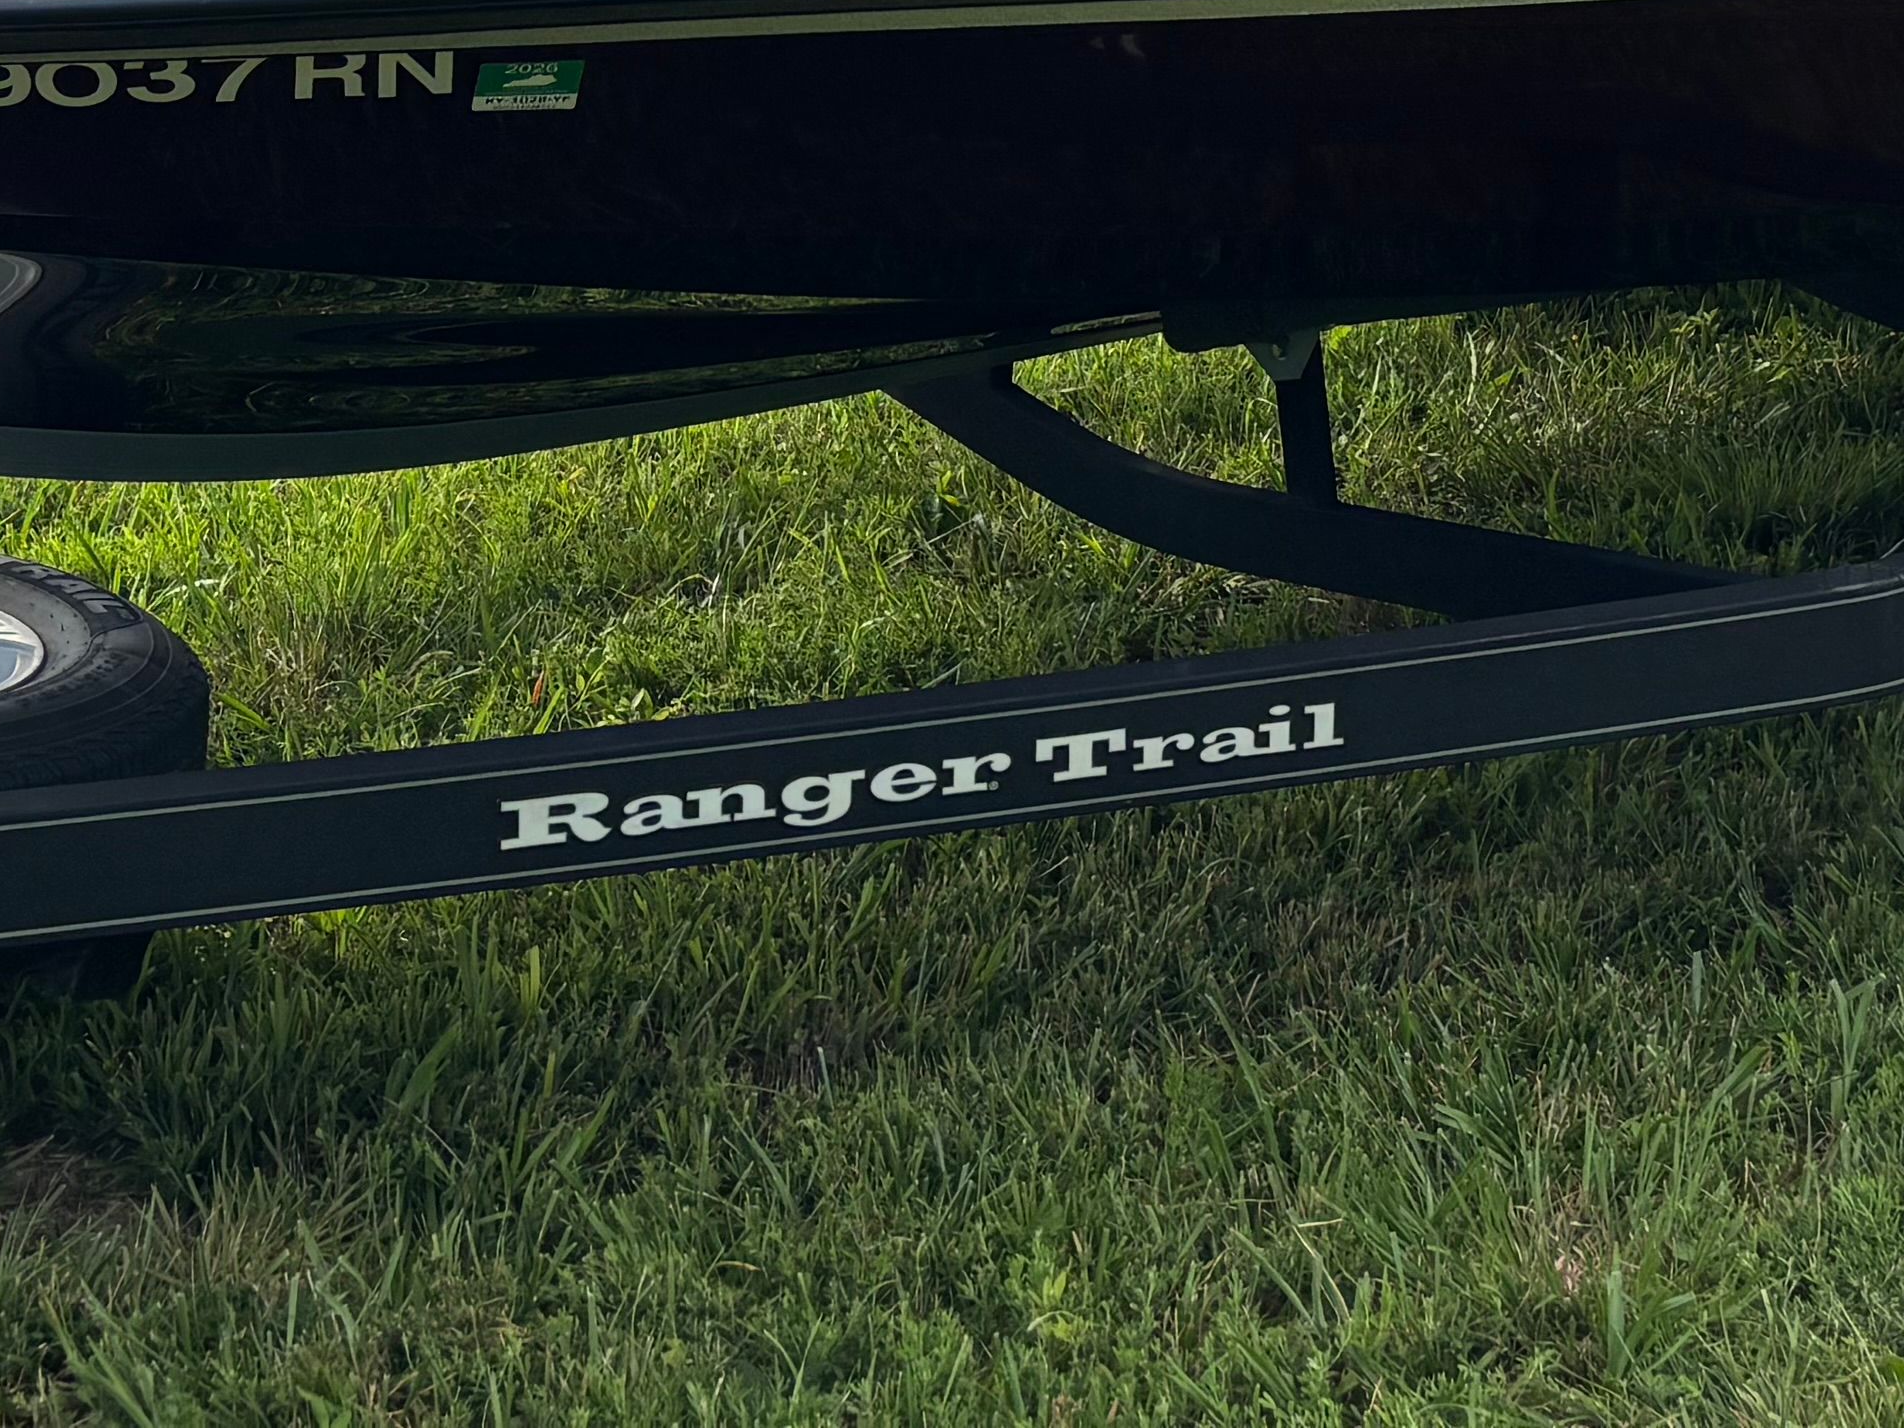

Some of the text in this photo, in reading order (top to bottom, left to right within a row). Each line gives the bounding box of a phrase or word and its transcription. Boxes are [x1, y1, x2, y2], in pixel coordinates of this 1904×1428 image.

[294, 50, 455, 100] RN
[499, 701, 1346, 851] Ranger Trail
